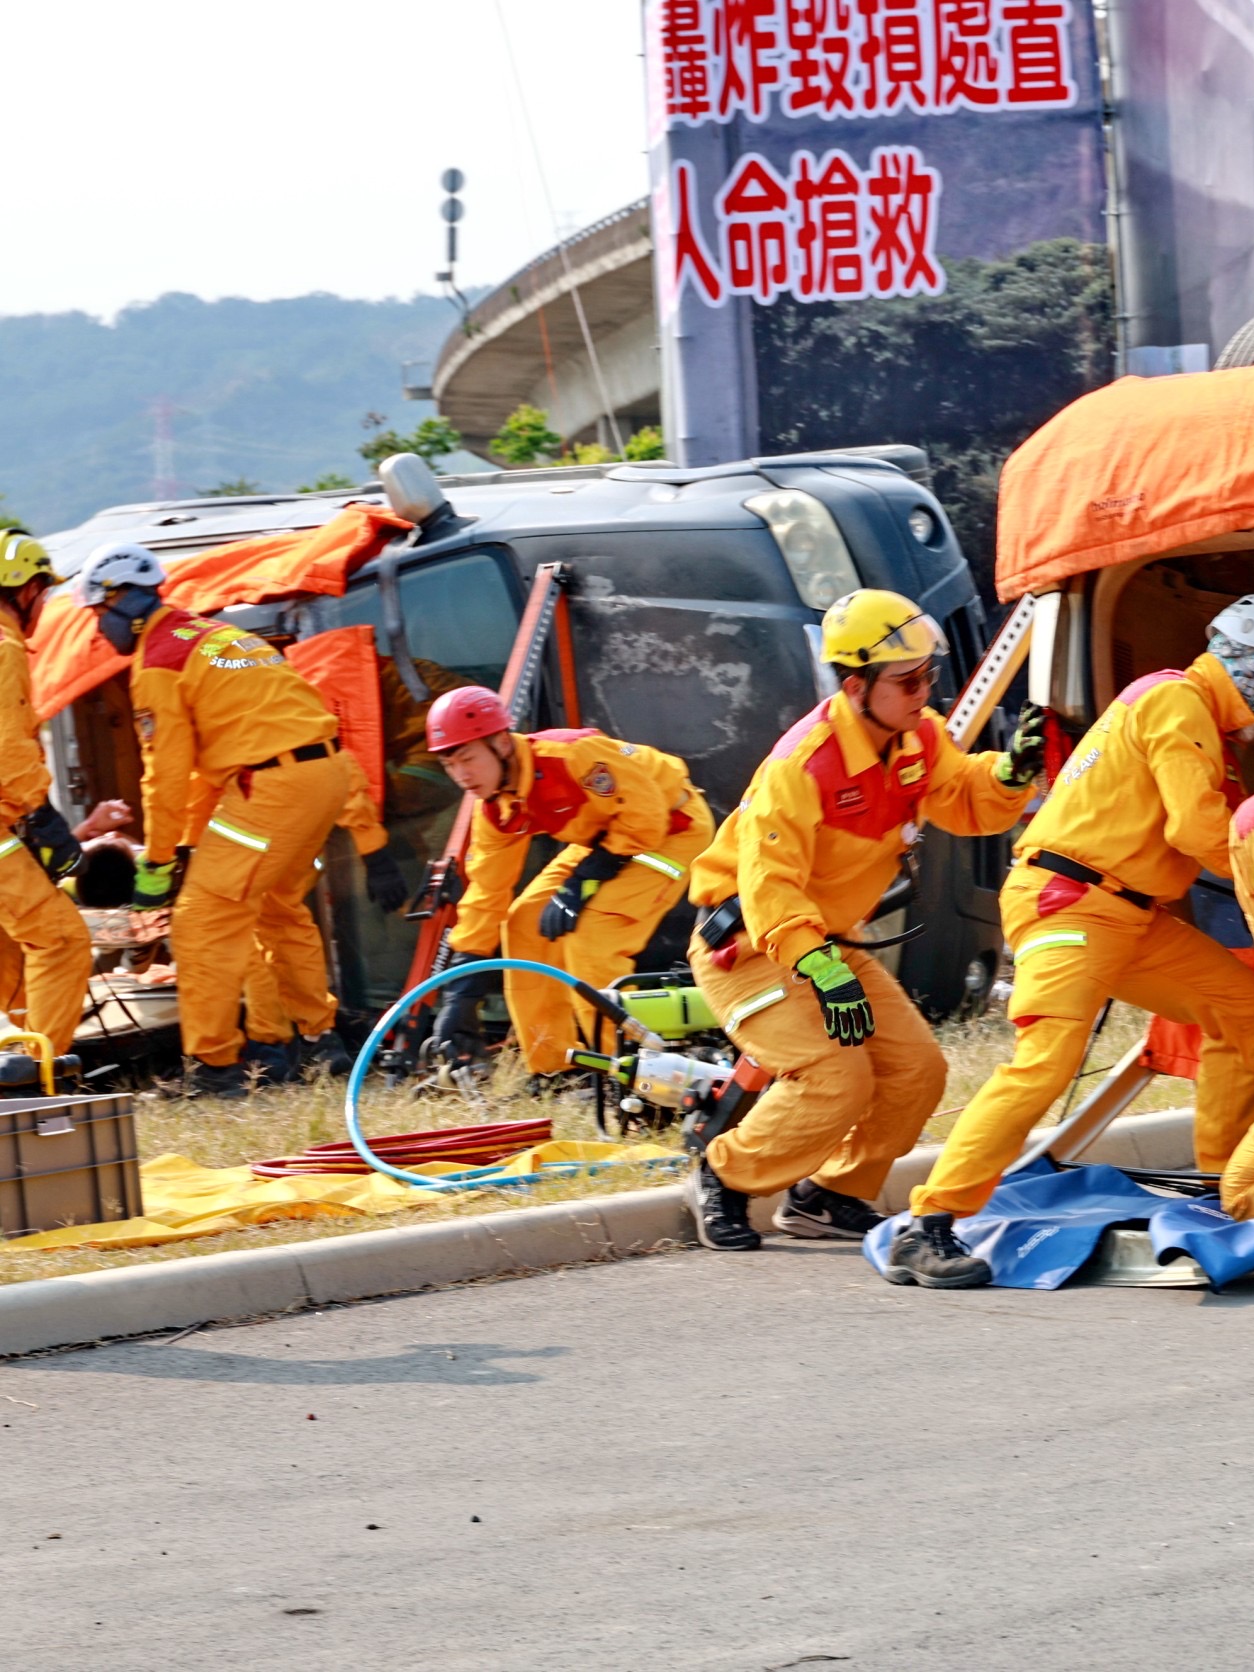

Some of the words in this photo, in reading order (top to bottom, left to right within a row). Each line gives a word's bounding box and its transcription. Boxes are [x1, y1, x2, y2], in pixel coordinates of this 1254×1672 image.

[674, 149, 940, 303] 人命搶救
[1062, 746, 1102, 786] TEAM
